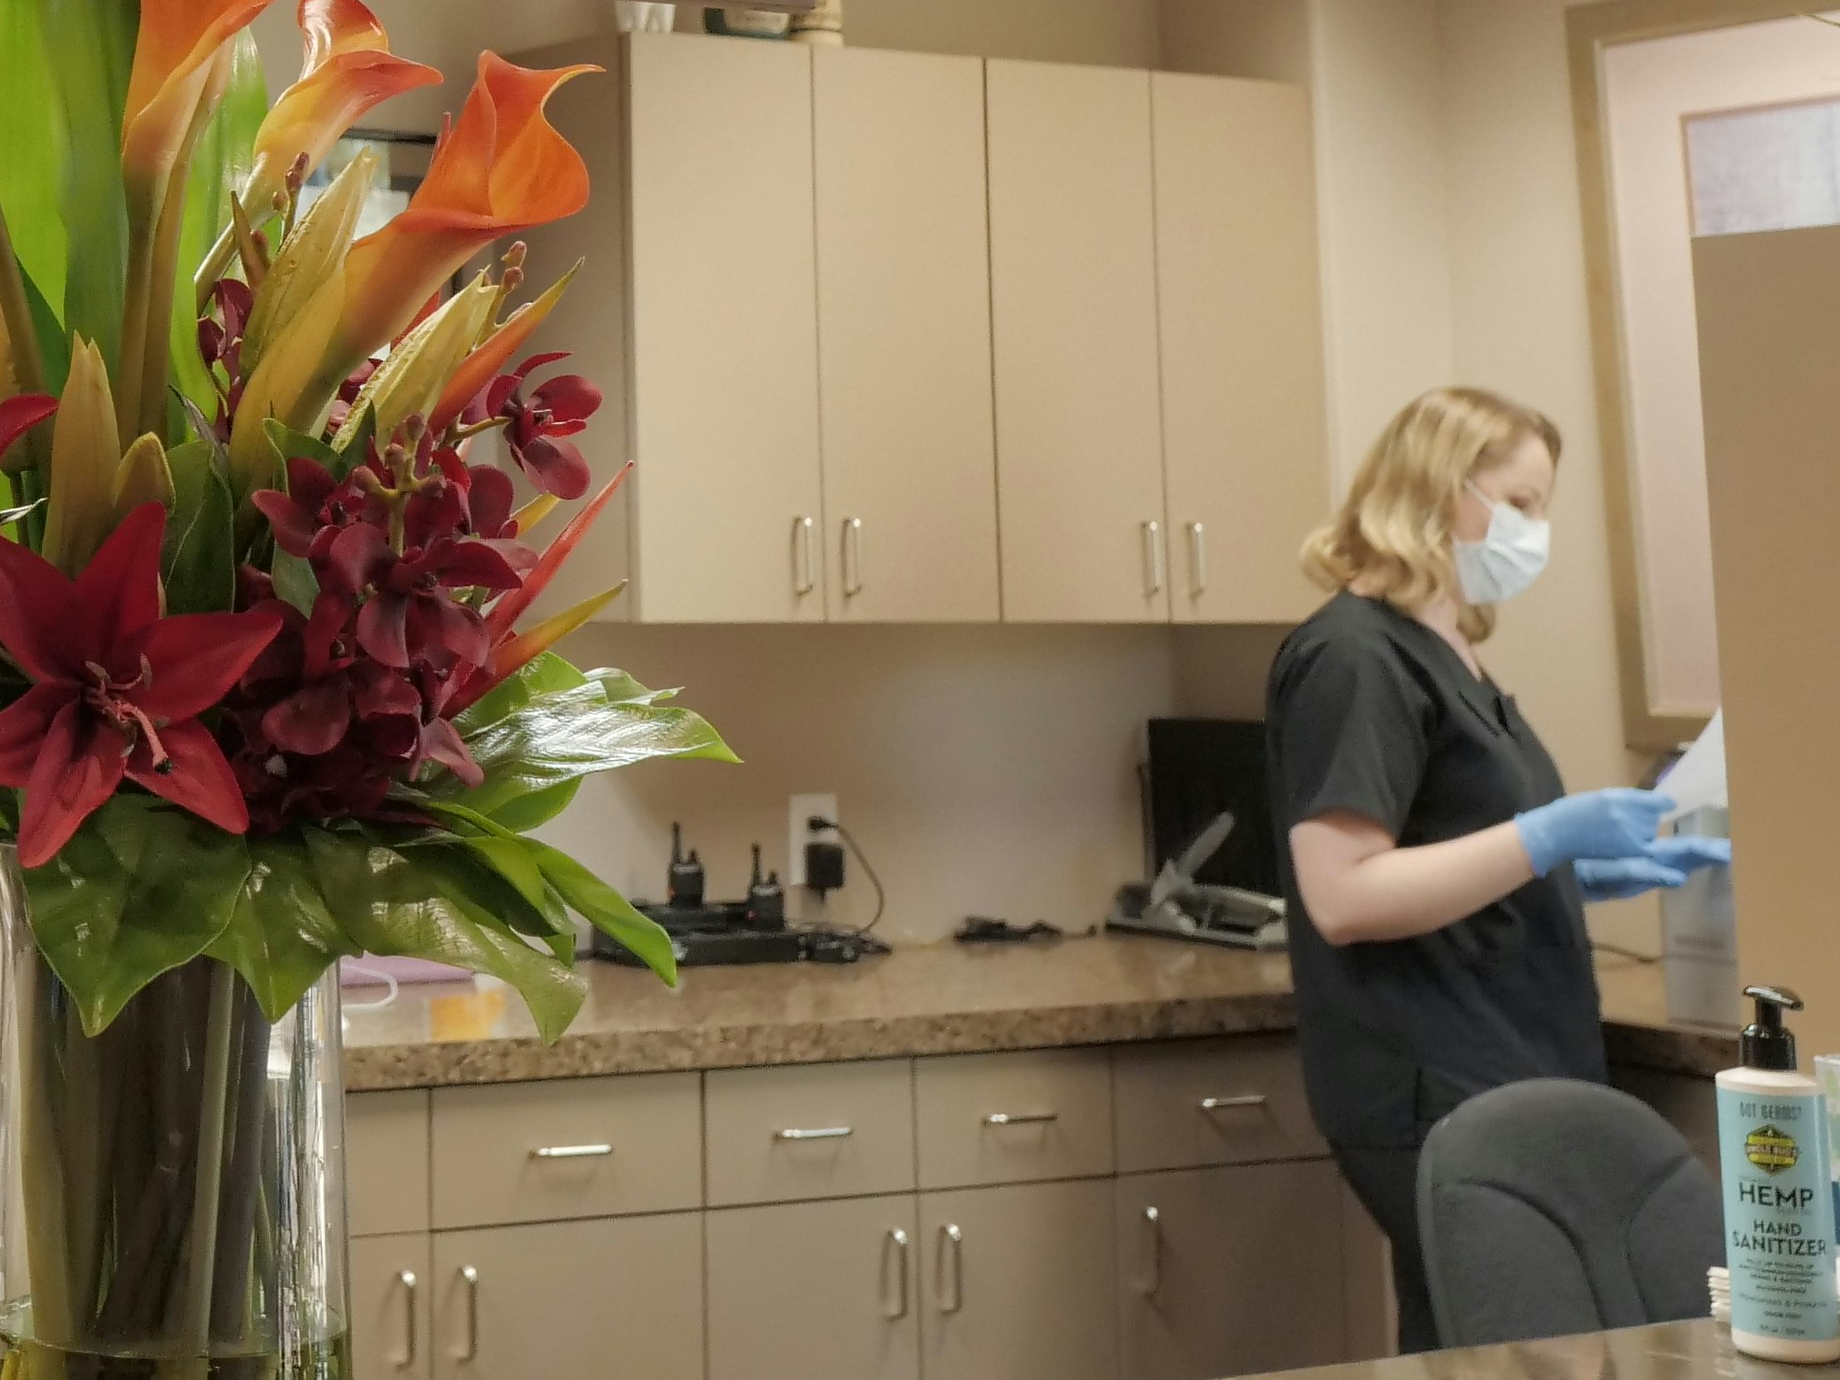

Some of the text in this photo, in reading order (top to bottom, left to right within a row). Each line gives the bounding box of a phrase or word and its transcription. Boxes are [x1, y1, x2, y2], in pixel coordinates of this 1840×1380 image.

[1739, 1181, 1814, 1209] HEMP
[1754, 1219, 1802, 1237] HAND
[1733, 1229, 1826, 1257] SANITIZER
